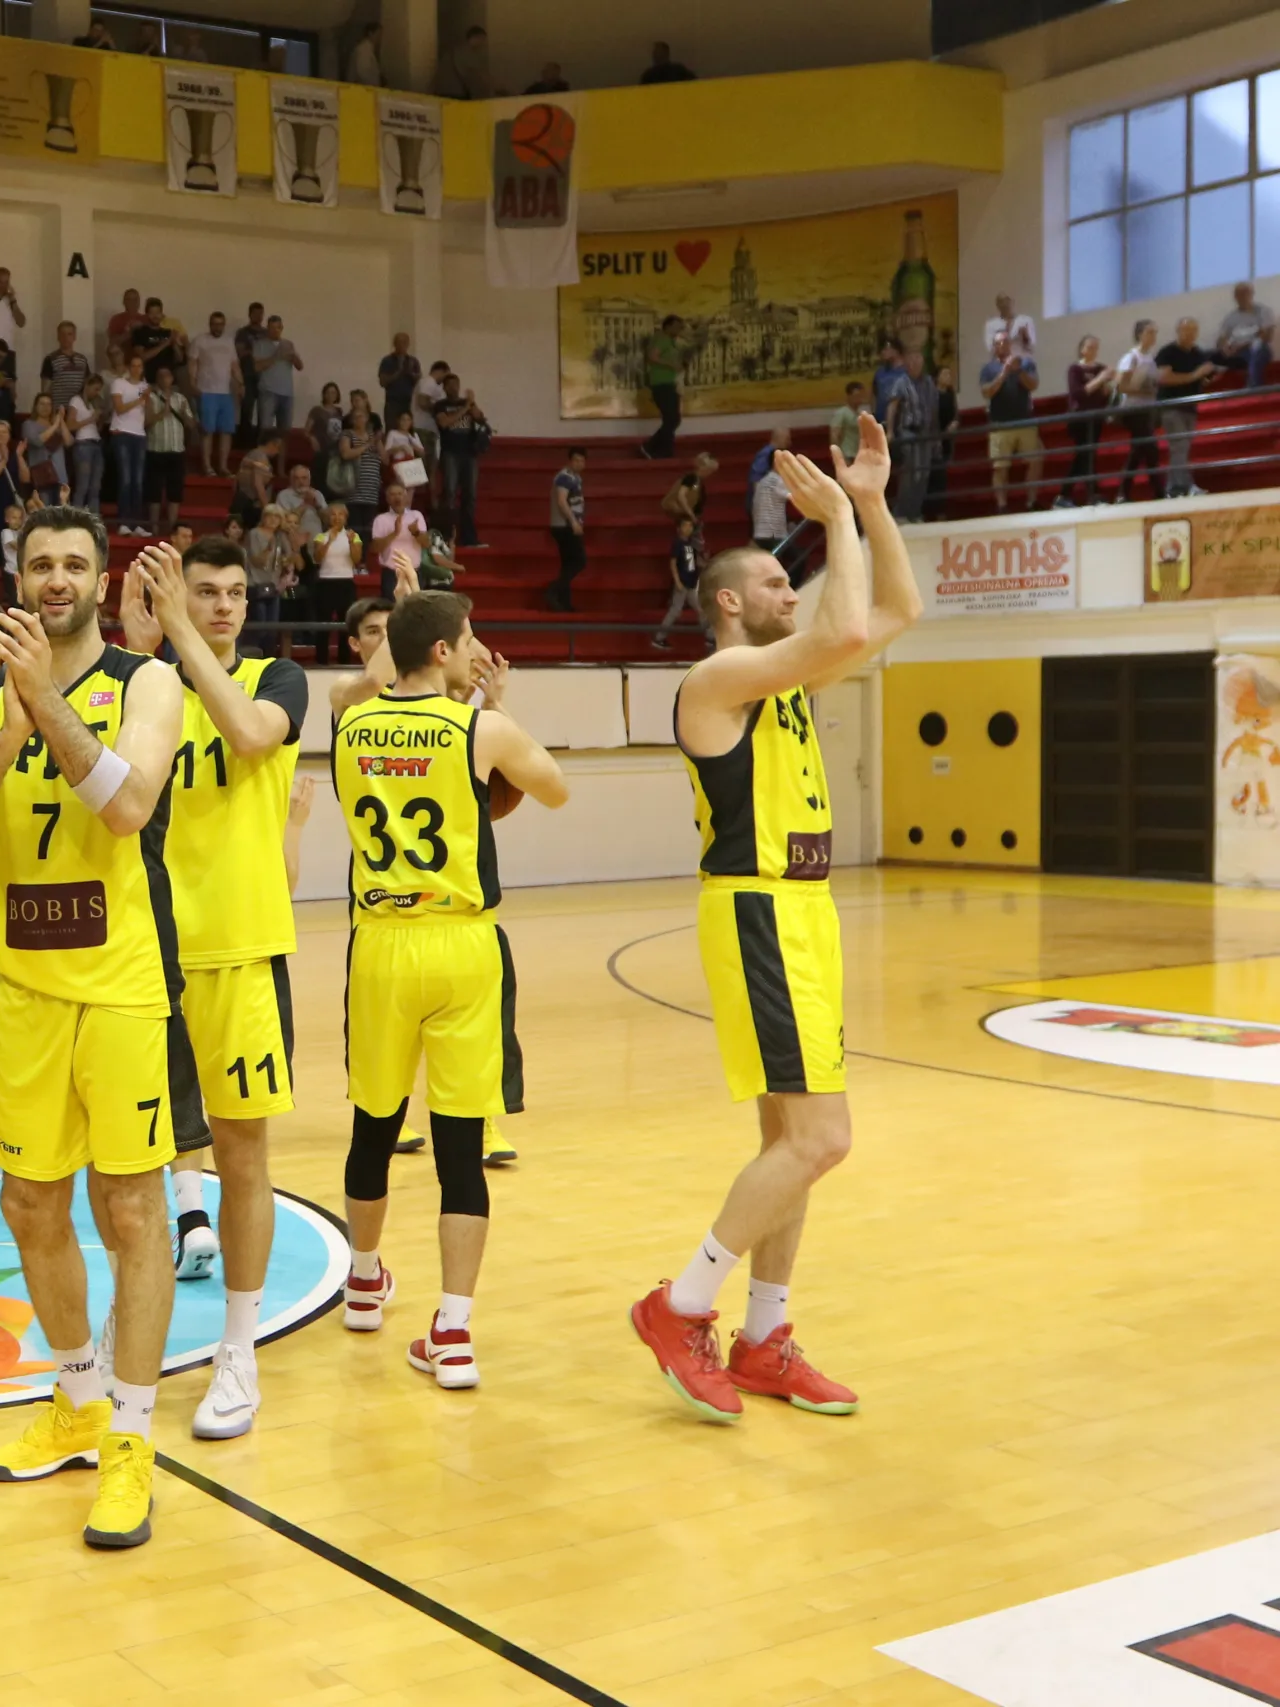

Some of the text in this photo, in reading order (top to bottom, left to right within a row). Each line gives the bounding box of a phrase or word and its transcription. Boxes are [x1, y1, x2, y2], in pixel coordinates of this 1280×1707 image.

[500, 176, 561, 219] ABA
[67, 252, 90, 279] A
[583, 250, 668, 276] SPLIT U
[936, 530, 1070, 580] komis
[1024, 576, 1066, 588] OPREMA
[345, 724, 453, 748] VRUČINIĆ
[175, 736, 228, 789] 11
[357, 756, 433, 776] TOMMY
[31, 803, 61, 860] 7
[353, 795, 449, 873] 33
[9, 896, 105, 922] BOBIS
[226, 1052, 278, 1099] 11
[137, 1096, 161, 1148] 7
